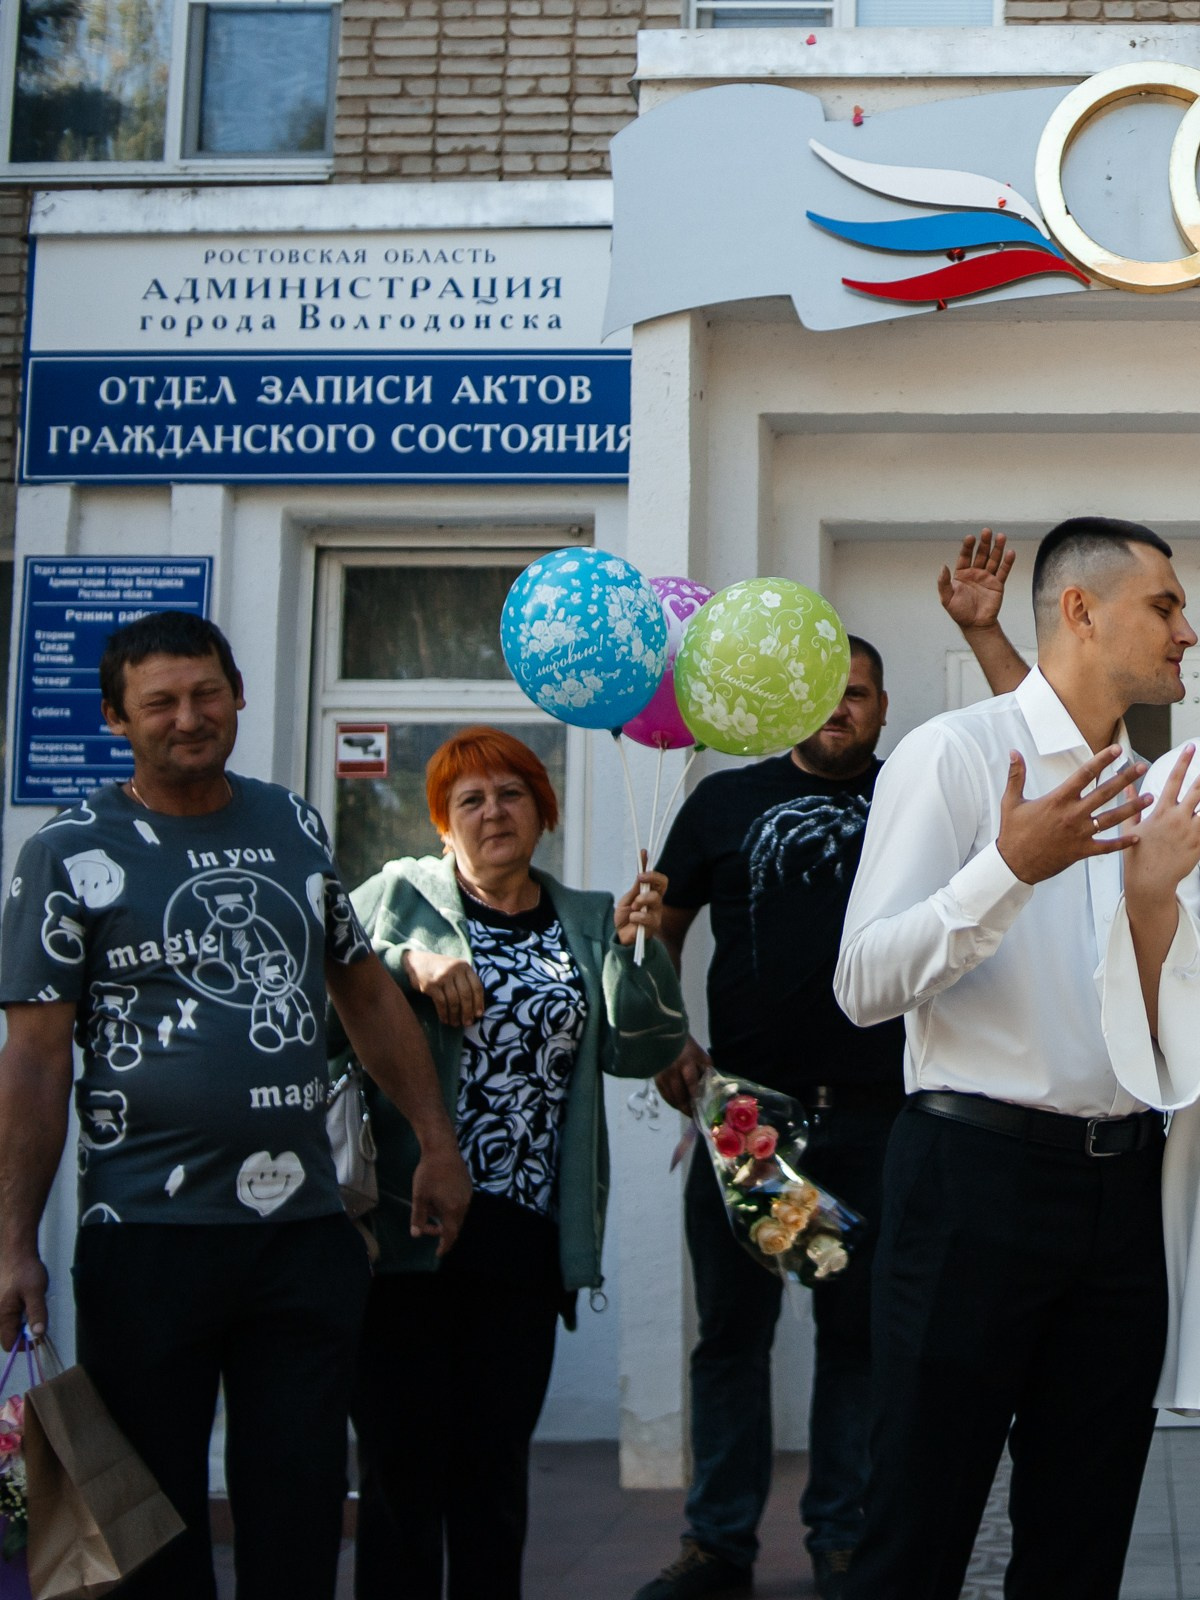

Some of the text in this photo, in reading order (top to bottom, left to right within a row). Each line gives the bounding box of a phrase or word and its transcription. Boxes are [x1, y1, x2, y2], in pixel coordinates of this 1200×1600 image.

[203, 247, 498, 266] РОСТОВСКАЯ ОБЛАСТЬ
[141, 275, 563, 305] АДМИНИСТРАЦИЯ
[139, 303, 563, 338] города Волгодонска
[98, 375, 593, 411] ОТДЕЛ ЗАПИСИ АКТОВ
[47, 423, 377, 460] ГРАЖДАНСКОГО
[65, 608, 114, 622] Режим
[519, 661, 532, 681] С
[737, 653, 756, 669] С
[710, 657, 790, 704] Любовью!
[186, 848, 277, 869] in you
[105, 928, 219, 970] magie
